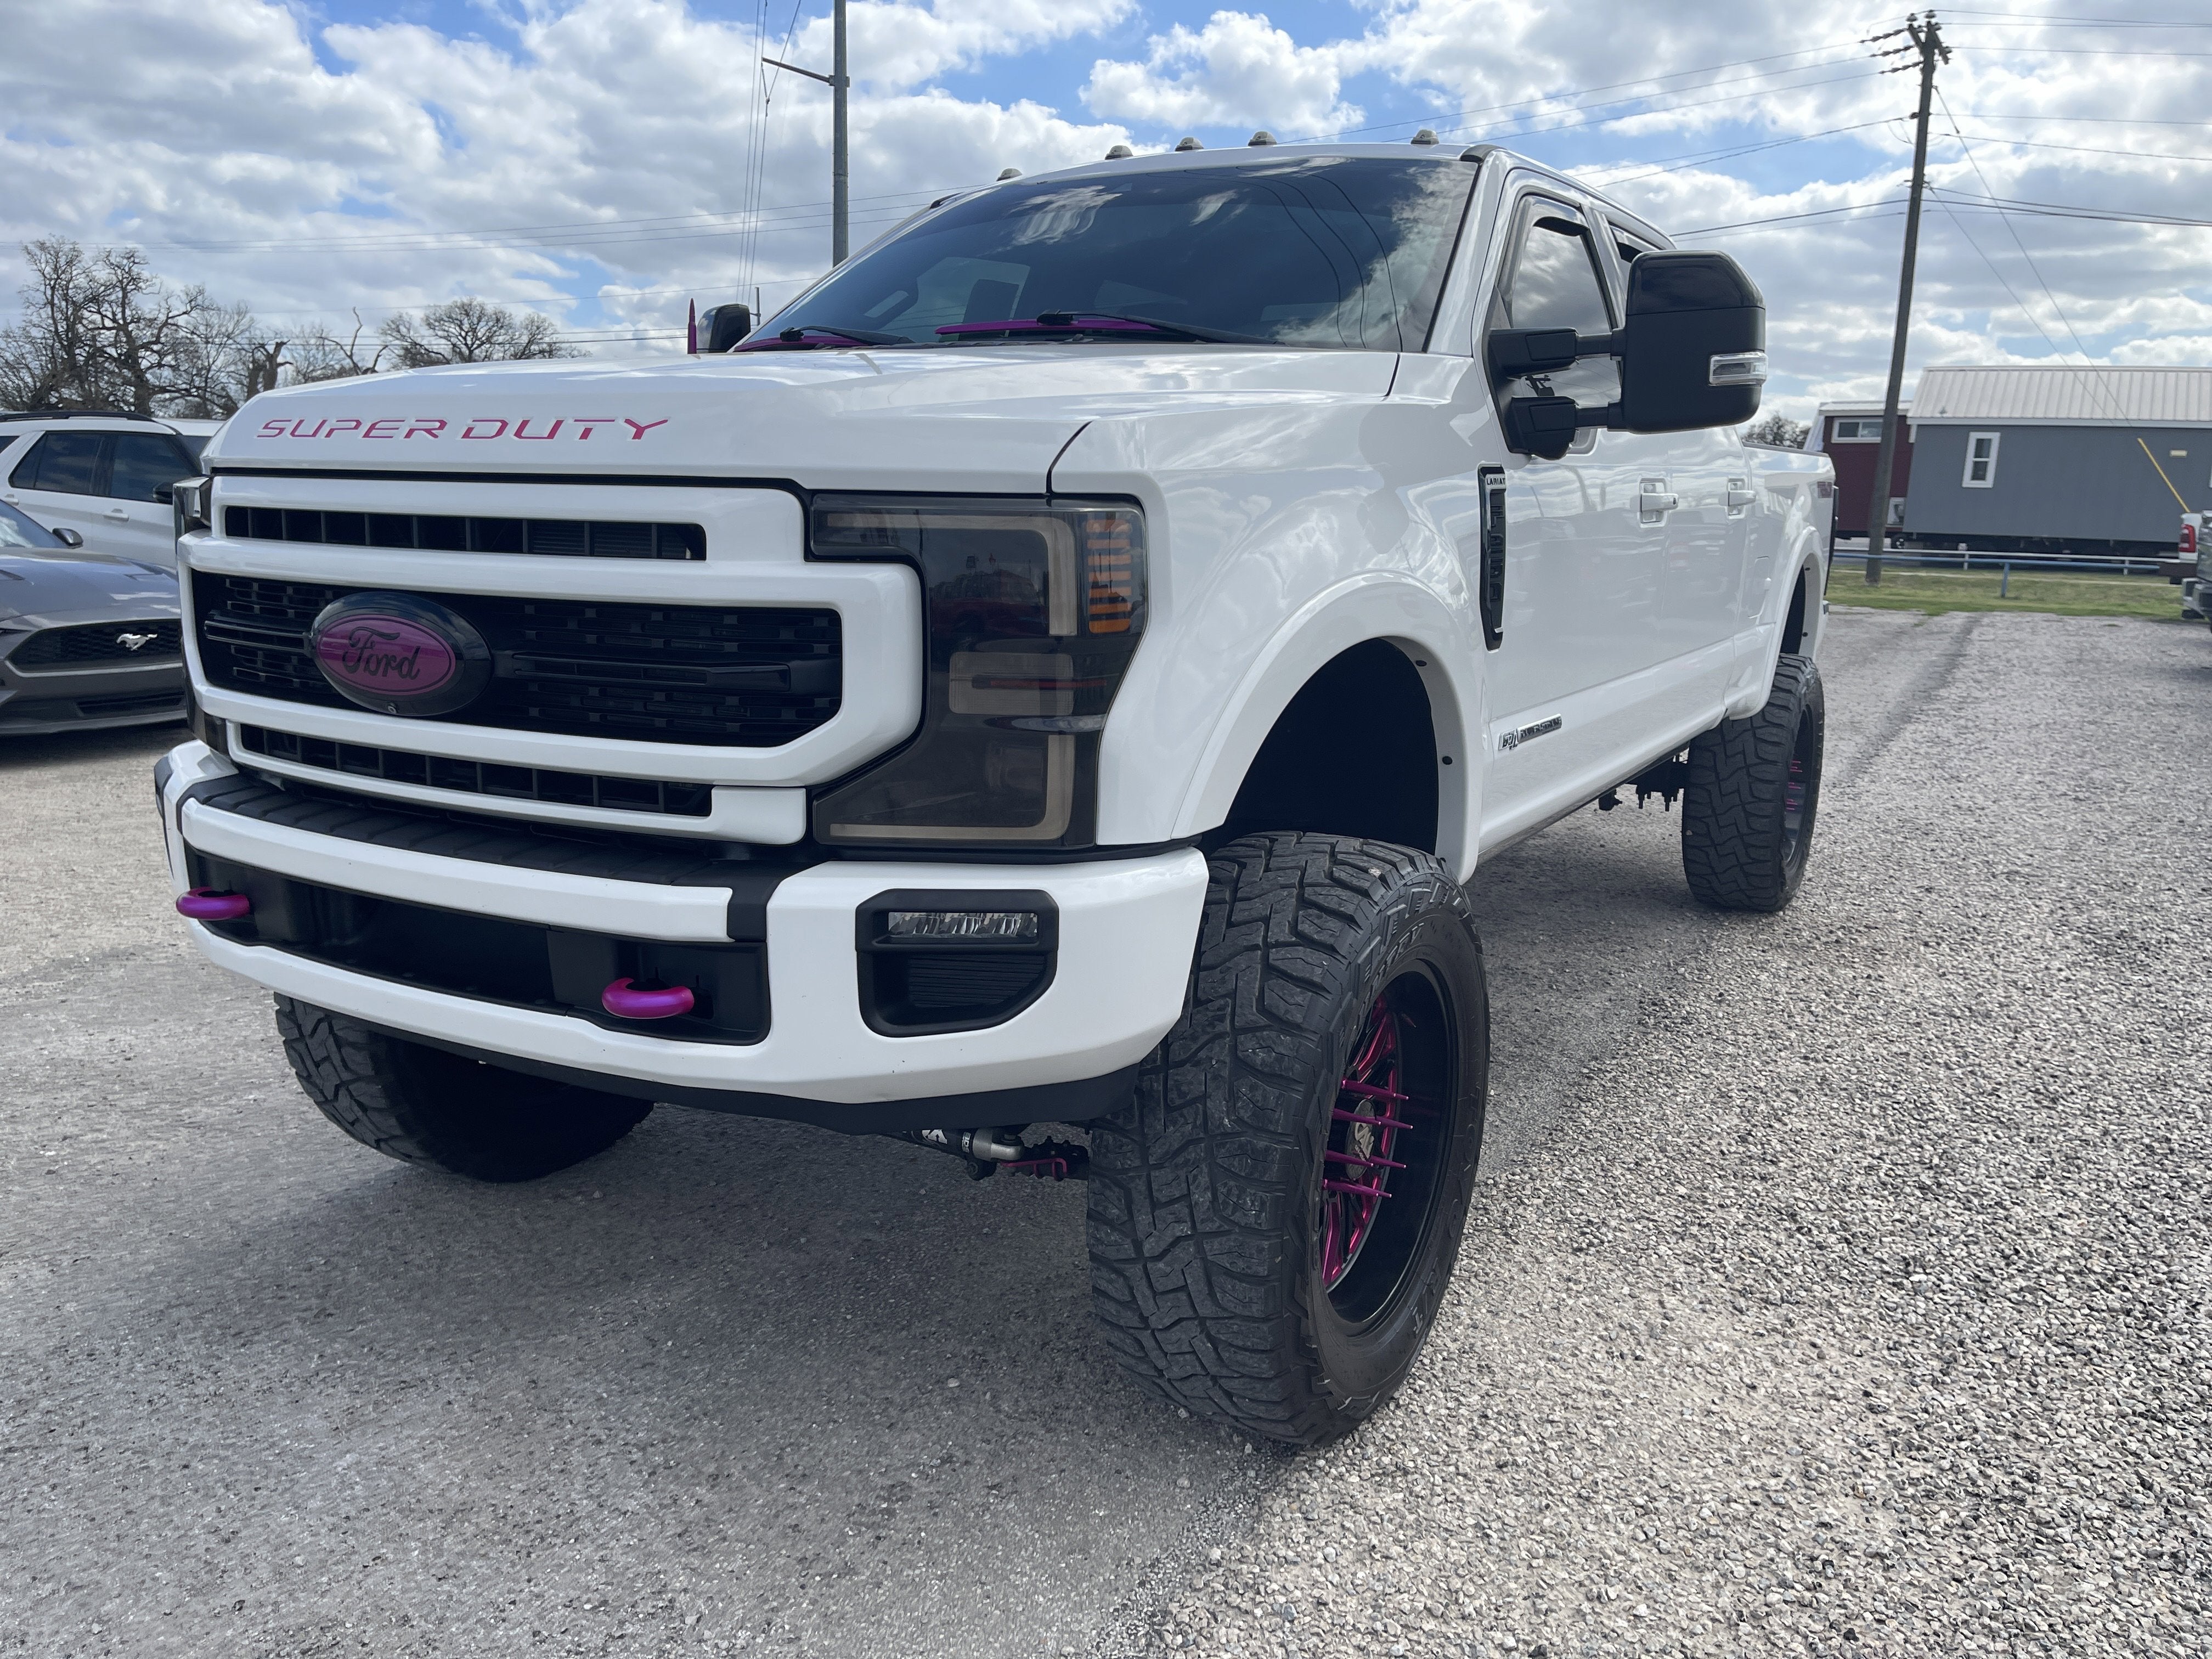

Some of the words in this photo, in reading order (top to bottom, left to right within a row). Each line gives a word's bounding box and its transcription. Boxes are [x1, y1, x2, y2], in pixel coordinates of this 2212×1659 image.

[256, 419, 447, 439] SUPER
[461, 419, 669, 440] DUTY
[1486, 477, 1506, 486] LARIAT
[342, 626, 421, 680] Ford
